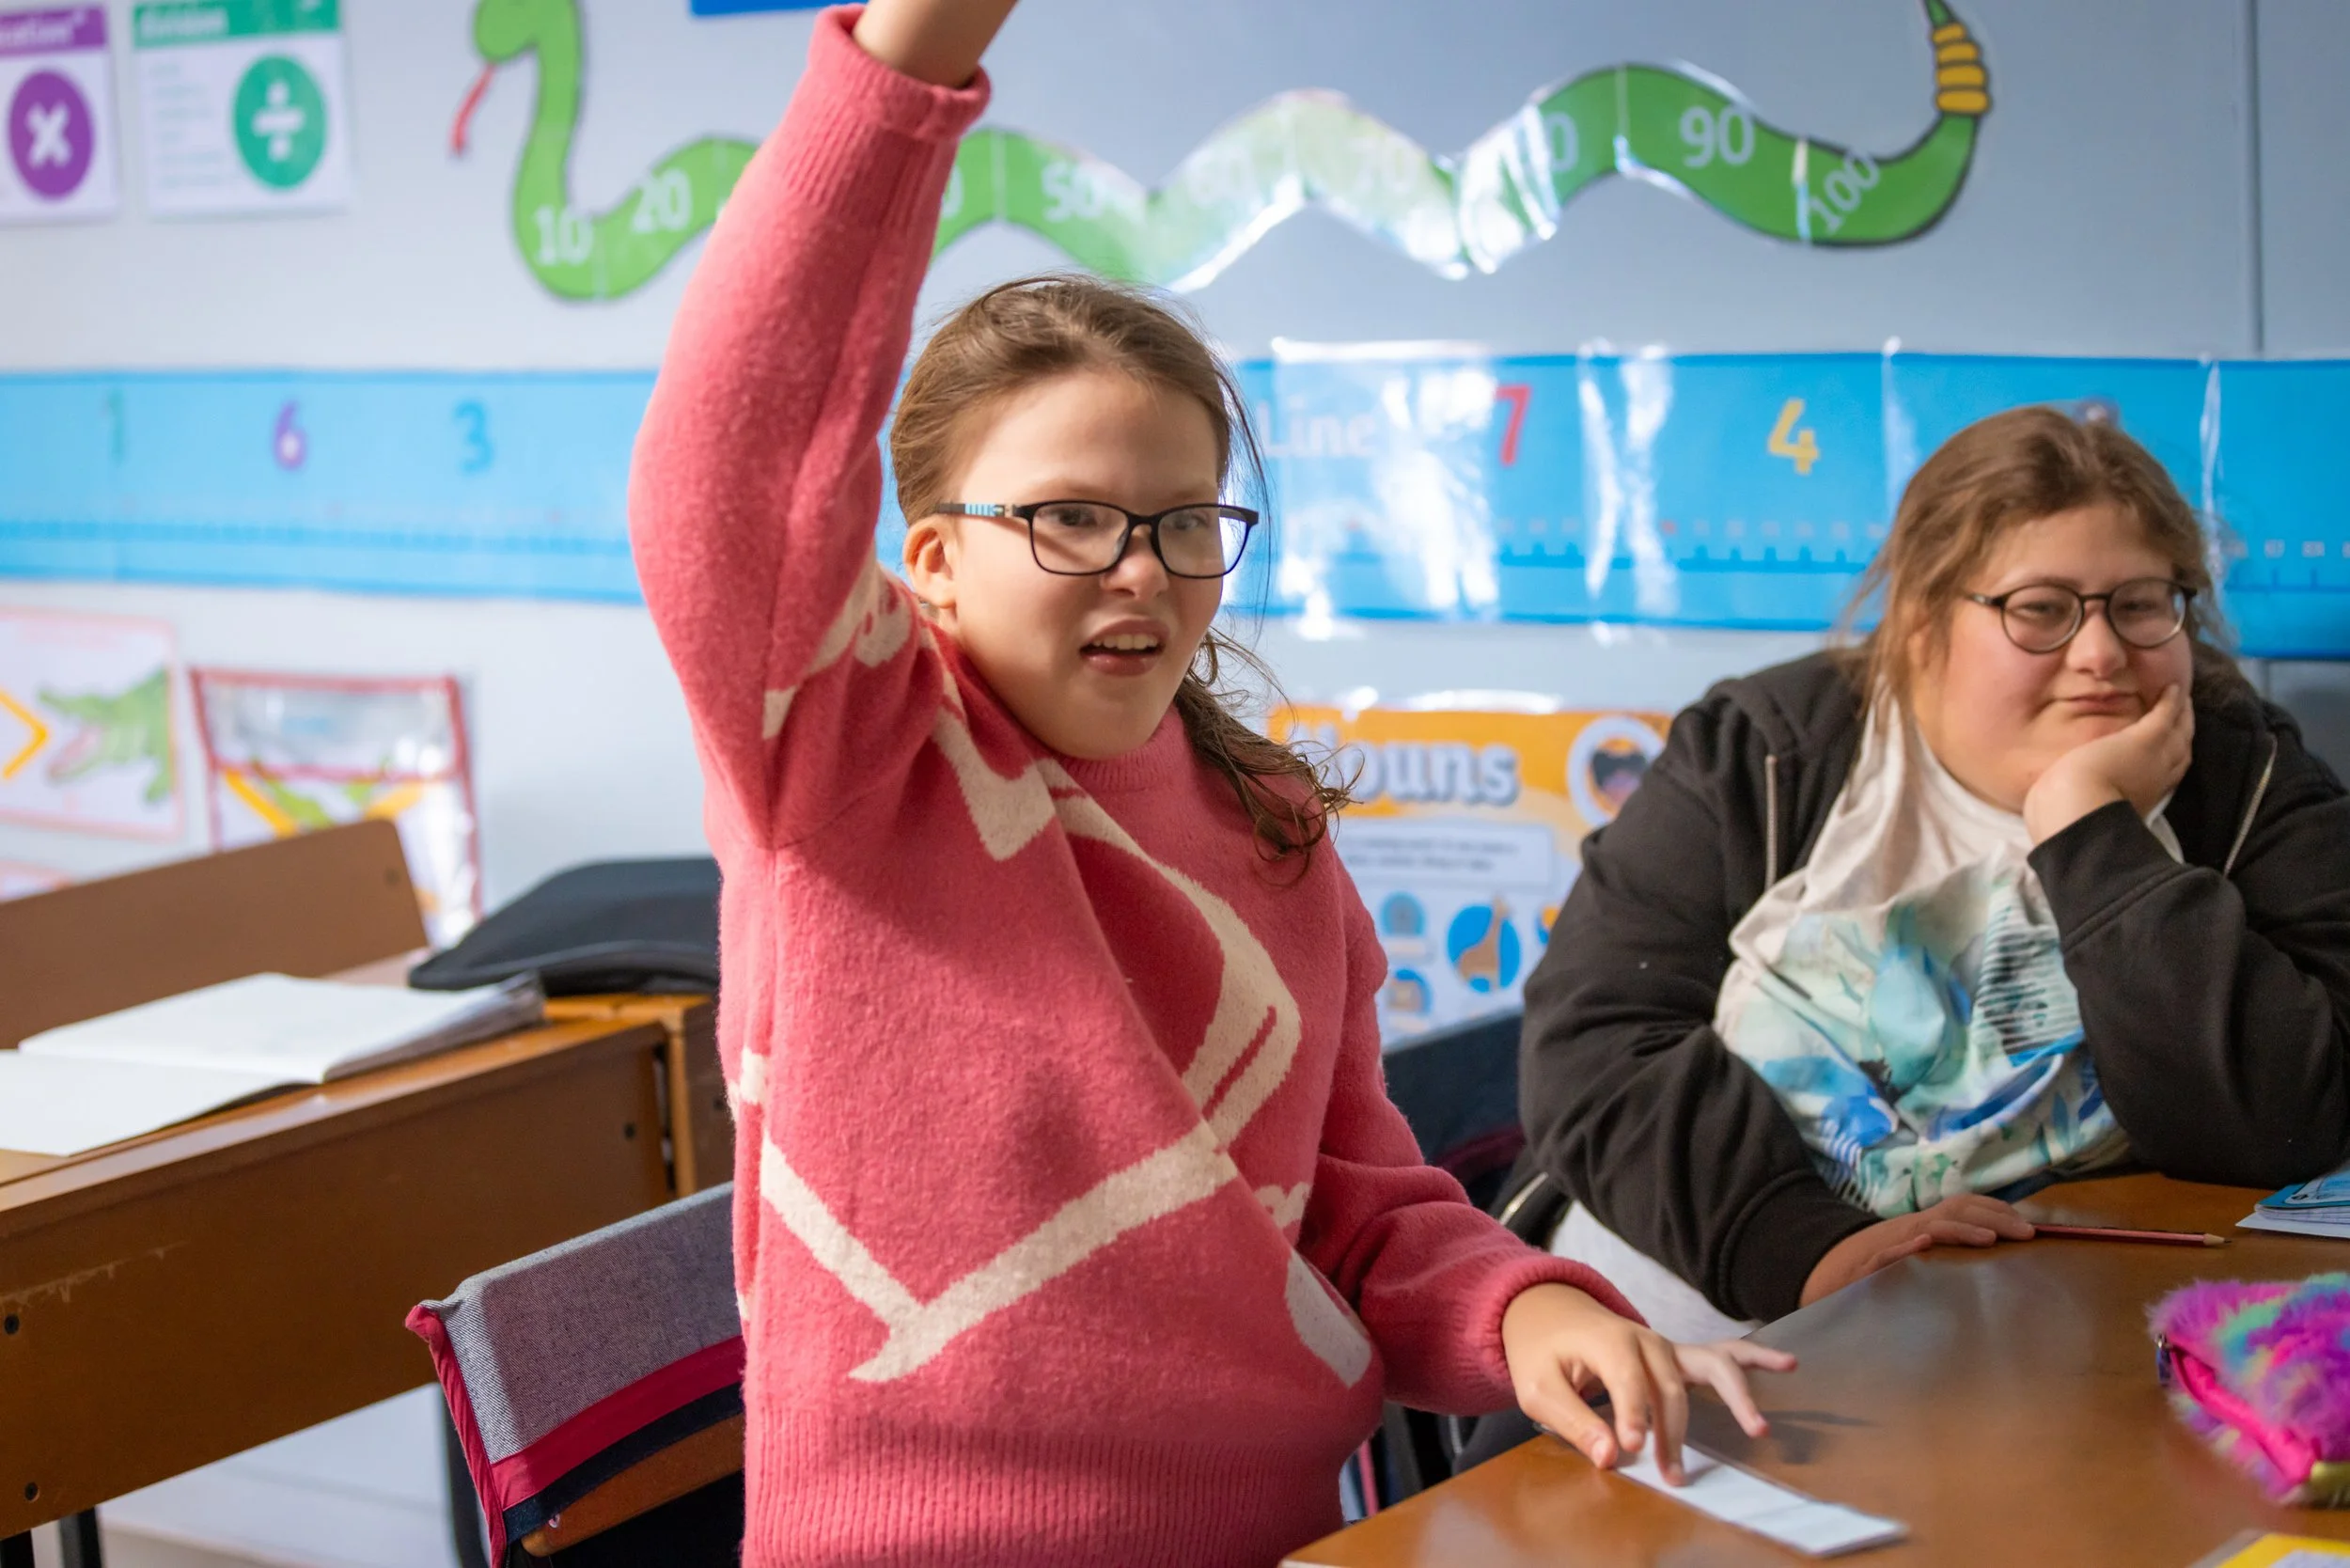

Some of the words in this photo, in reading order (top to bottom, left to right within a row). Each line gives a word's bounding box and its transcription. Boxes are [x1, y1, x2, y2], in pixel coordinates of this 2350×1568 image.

[1678, 105, 1755, 166] 90
[631, 167, 693, 234] 20
[1041, 161, 1104, 223] 50
[1808, 148, 1880, 233] 100
[533, 203, 593, 267] 10
[106, 388, 125, 466] 1
[272, 399, 308, 471] 6
[452, 400, 494, 473] 3
[1256, 395, 1376, 456] Line
[1494, 384, 1532, 465] 7
[1766, 397, 1821, 476] 4
